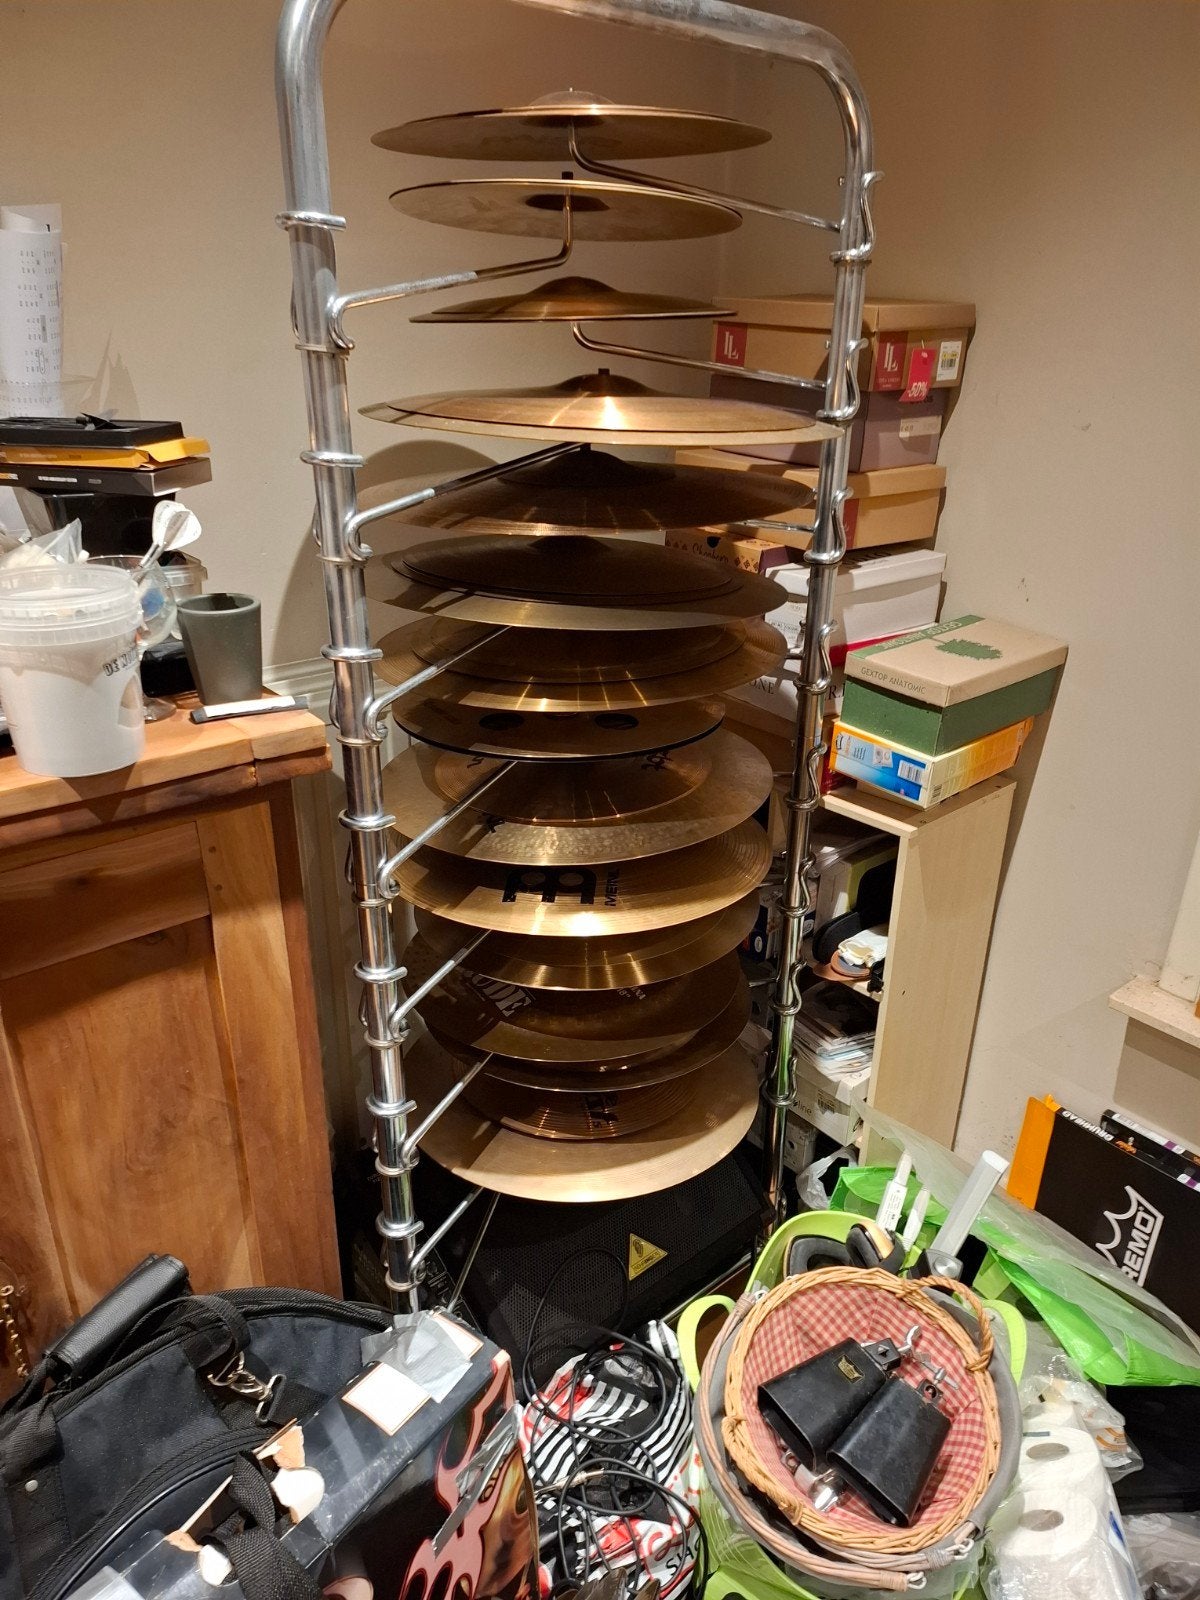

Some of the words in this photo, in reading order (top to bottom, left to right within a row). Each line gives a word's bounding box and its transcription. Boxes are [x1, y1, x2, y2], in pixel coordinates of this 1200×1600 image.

[861, 667, 888, 682] GEXTOP
[888, 676, 927, 695] ANATOMIC
[1062, 1110, 1115, 1142] DRUMHEAD
